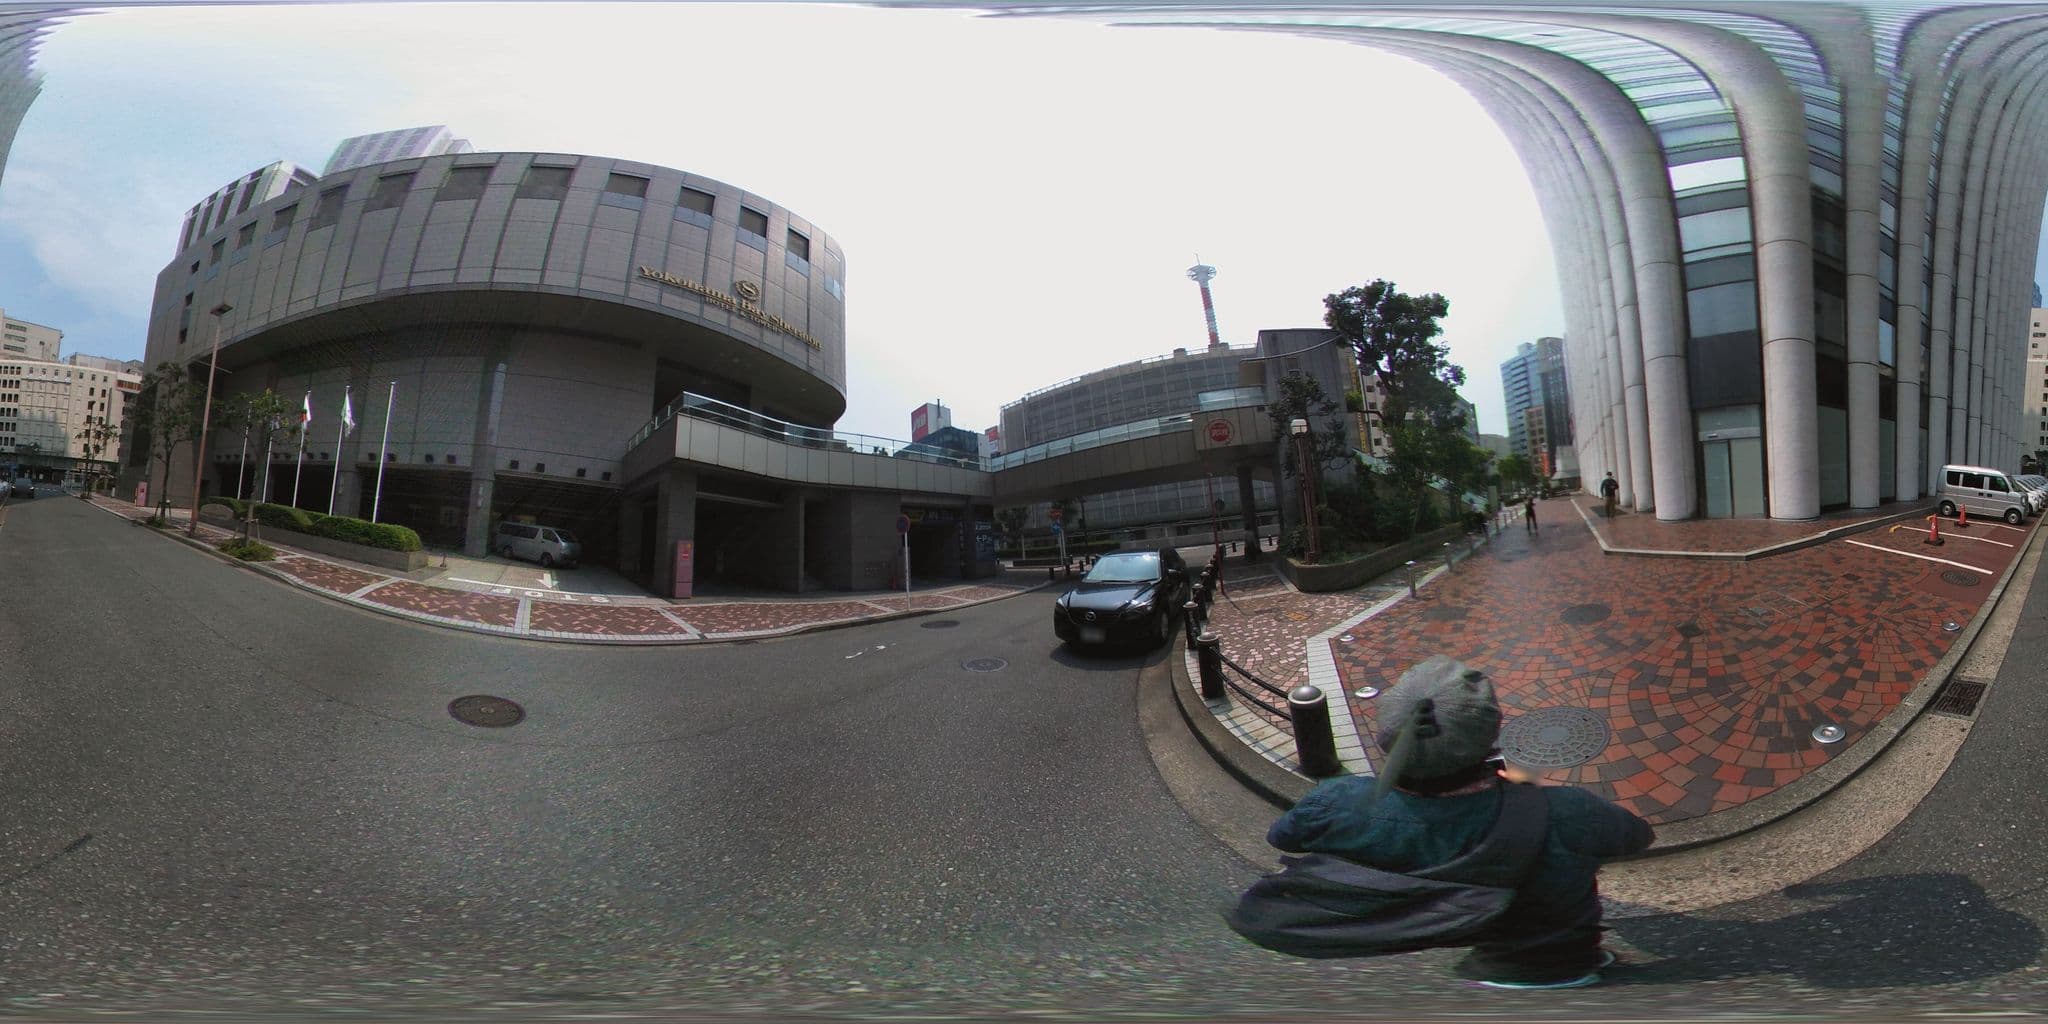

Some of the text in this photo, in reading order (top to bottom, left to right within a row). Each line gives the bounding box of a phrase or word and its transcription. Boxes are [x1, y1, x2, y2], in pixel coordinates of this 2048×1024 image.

[640, 264, 822, 349] Yokohama Bay Sheraton
